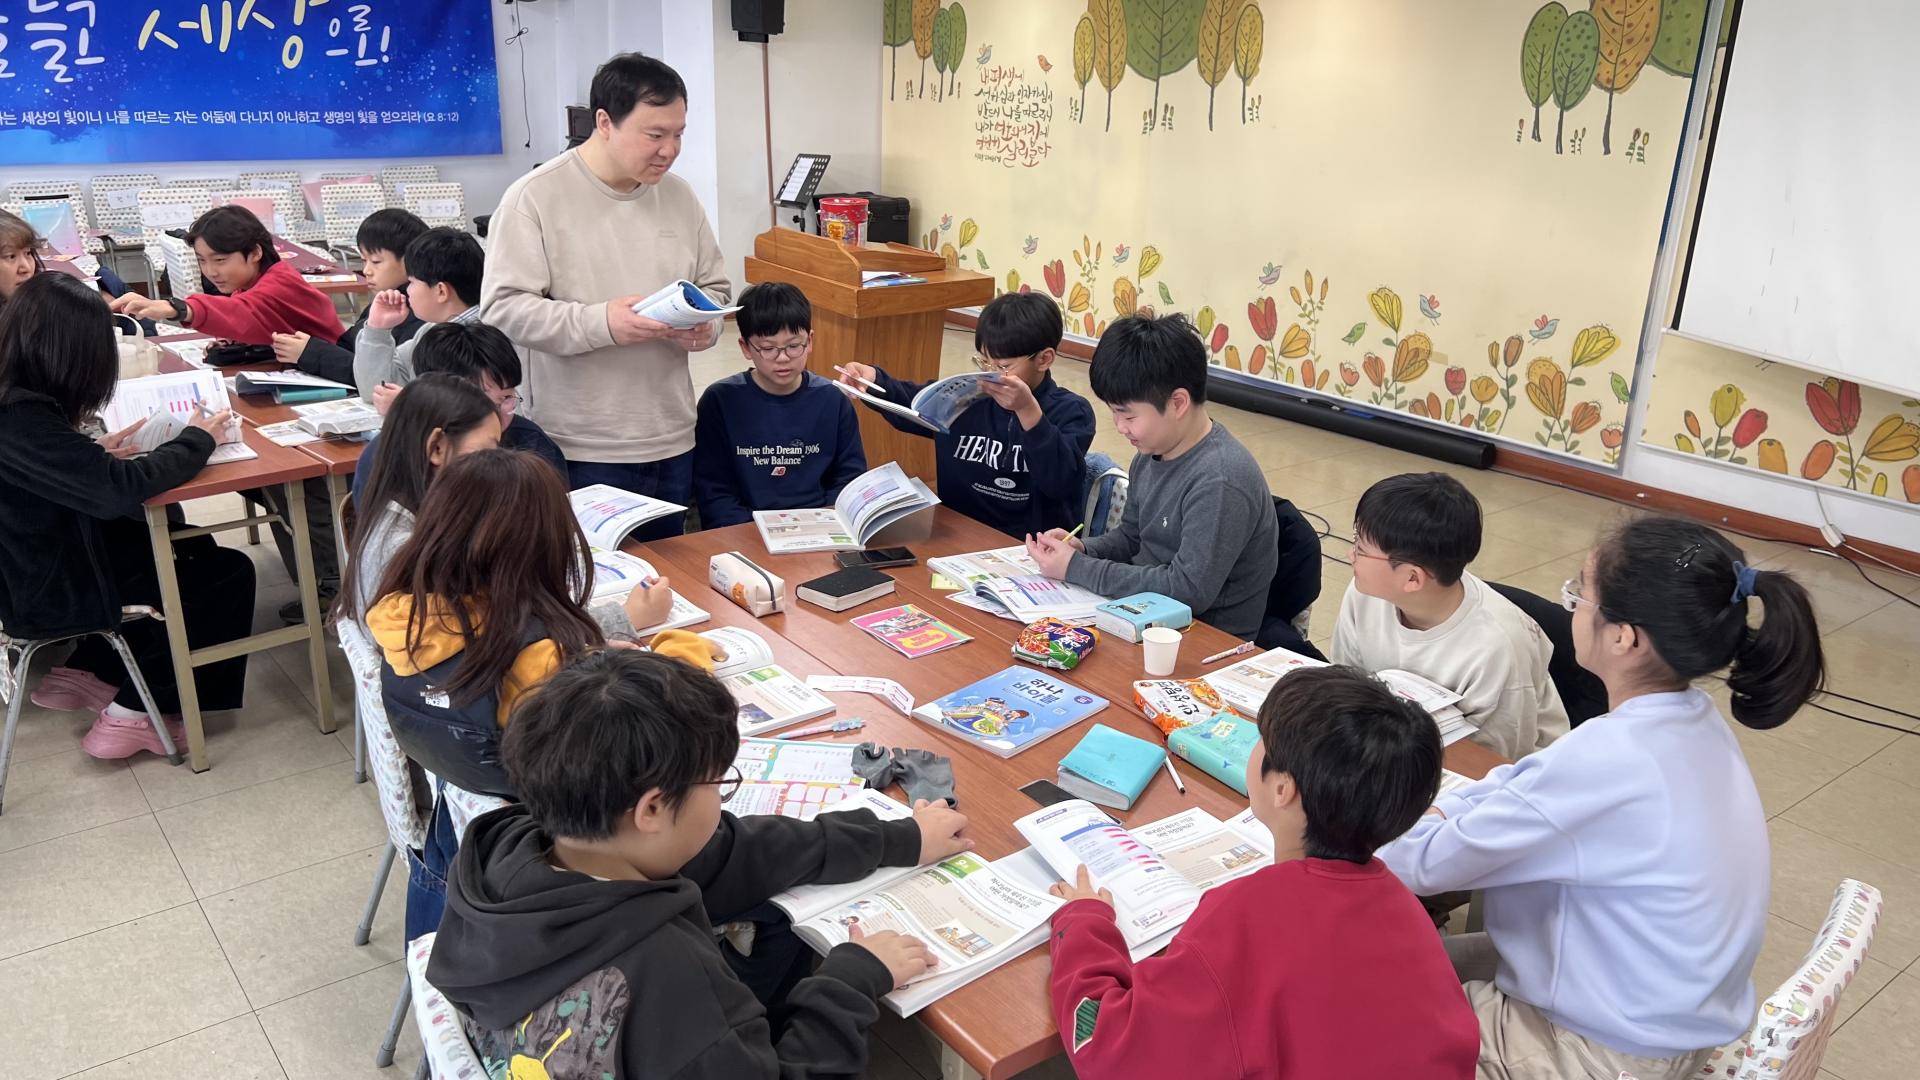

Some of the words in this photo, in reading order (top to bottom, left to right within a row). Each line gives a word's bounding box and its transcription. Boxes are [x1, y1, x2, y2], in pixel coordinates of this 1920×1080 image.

[21, 111, 60, 126] 세상의
[64, 109, 102, 125] 빛이니
[106, 110, 130, 125] 나를
[134, 110, 170, 125] 따르는
[174, 110, 198, 125] 자는
[202, 110, 236, 125] 어둠에
[240, 110, 273, 124] 다니지
[276, 110, 320, 124] 아니하고
[323, 110, 354, 124] 생명의
[357, 110, 377, 124] 빛을
[381, 111, 420, 124] 얻으리라
[736, 445, 761, 457] Inspire
[762, 445, 775, 455] the
[776, 445, 803, 455] Dream
[804, 443, 820, 454] 1906
[953, 435, 1030, 472] HEART
[753, 456, 770, 466] New
[771, 455, 802, 465] Balance
[1012, 682, 1060, 704] 바이블
[1030, 678, 1065, 695] 하나
[1154, 681, 1200, 716] 안성탕면
